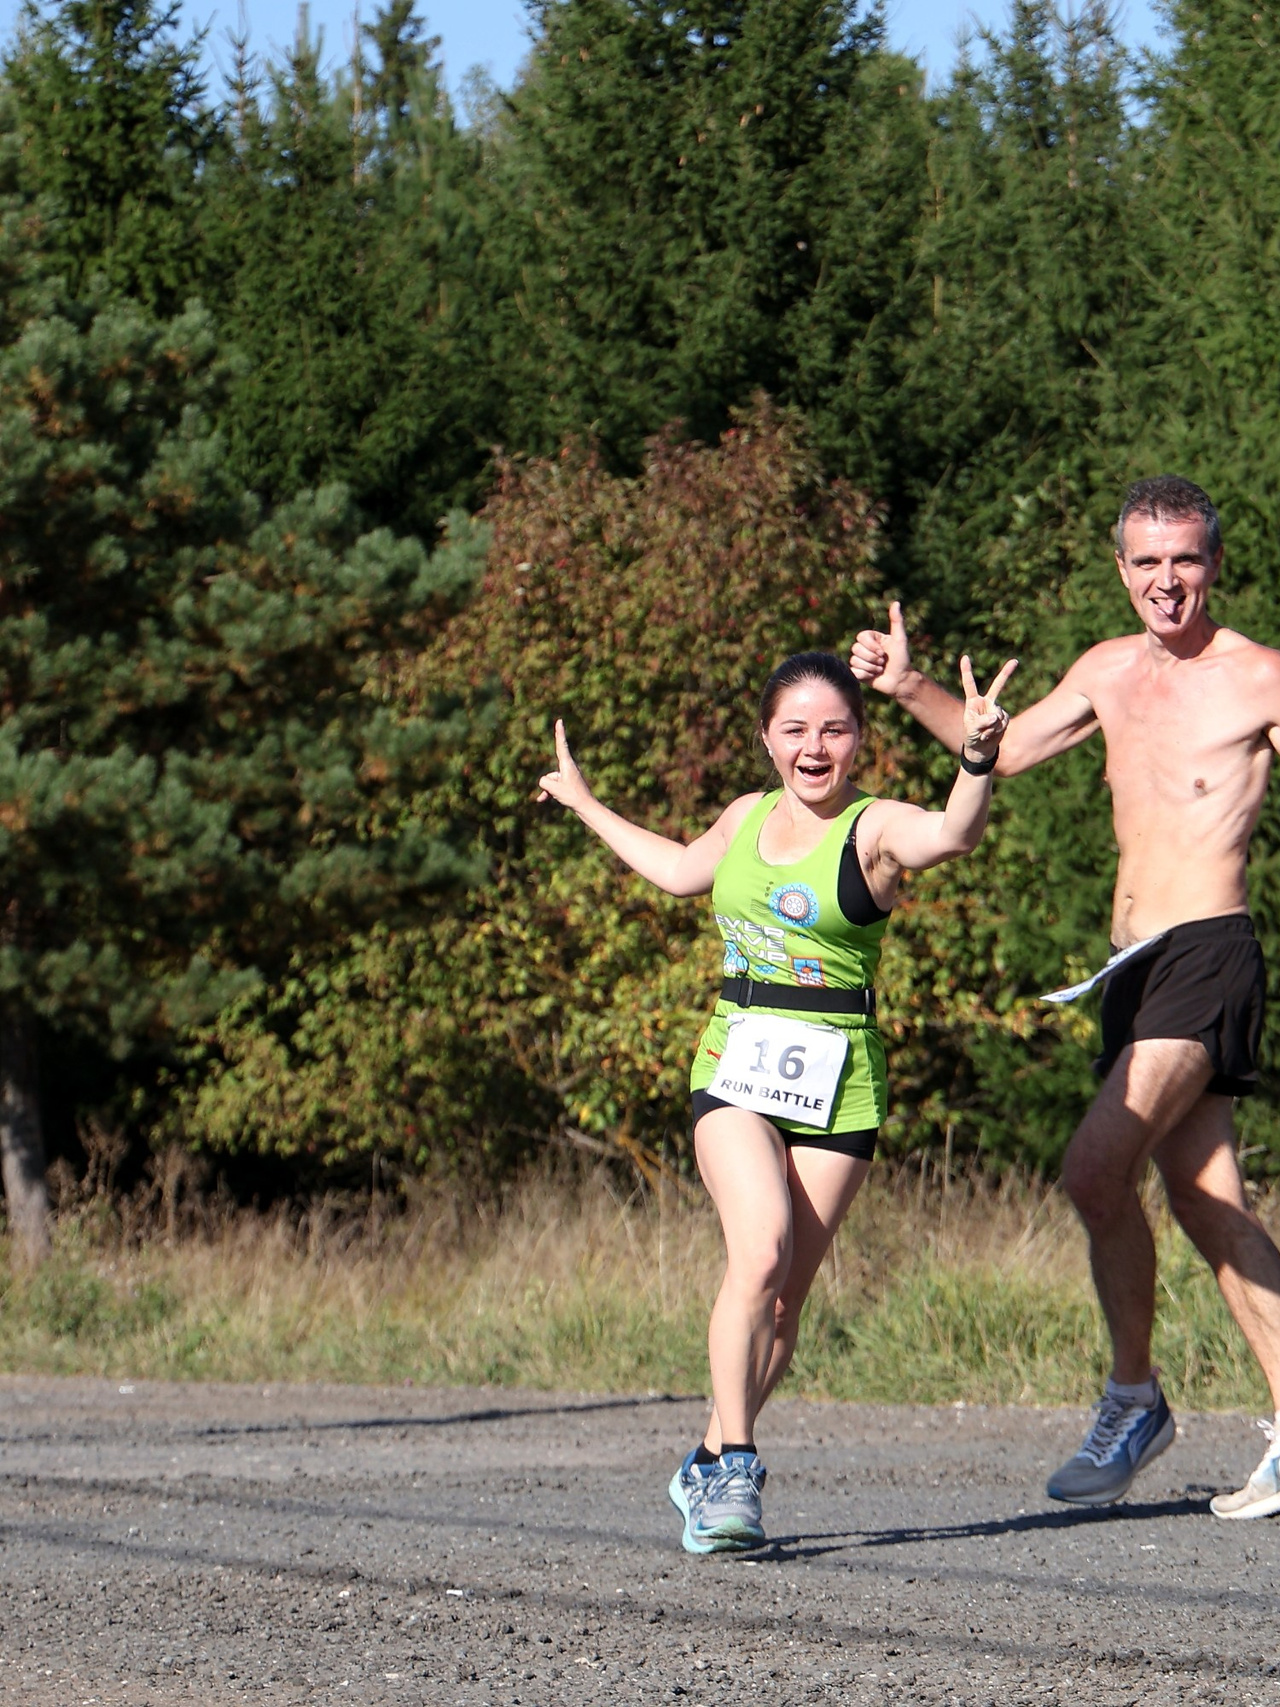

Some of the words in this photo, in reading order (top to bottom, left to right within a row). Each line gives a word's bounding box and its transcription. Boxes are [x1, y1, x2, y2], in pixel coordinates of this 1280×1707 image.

[746, 946, 788, 962] UP
[749, 1038, 807, 1080] 16
[720, 1079, 754, 1095] RUN
[758, 1087, 824, 1110] BATTLE
